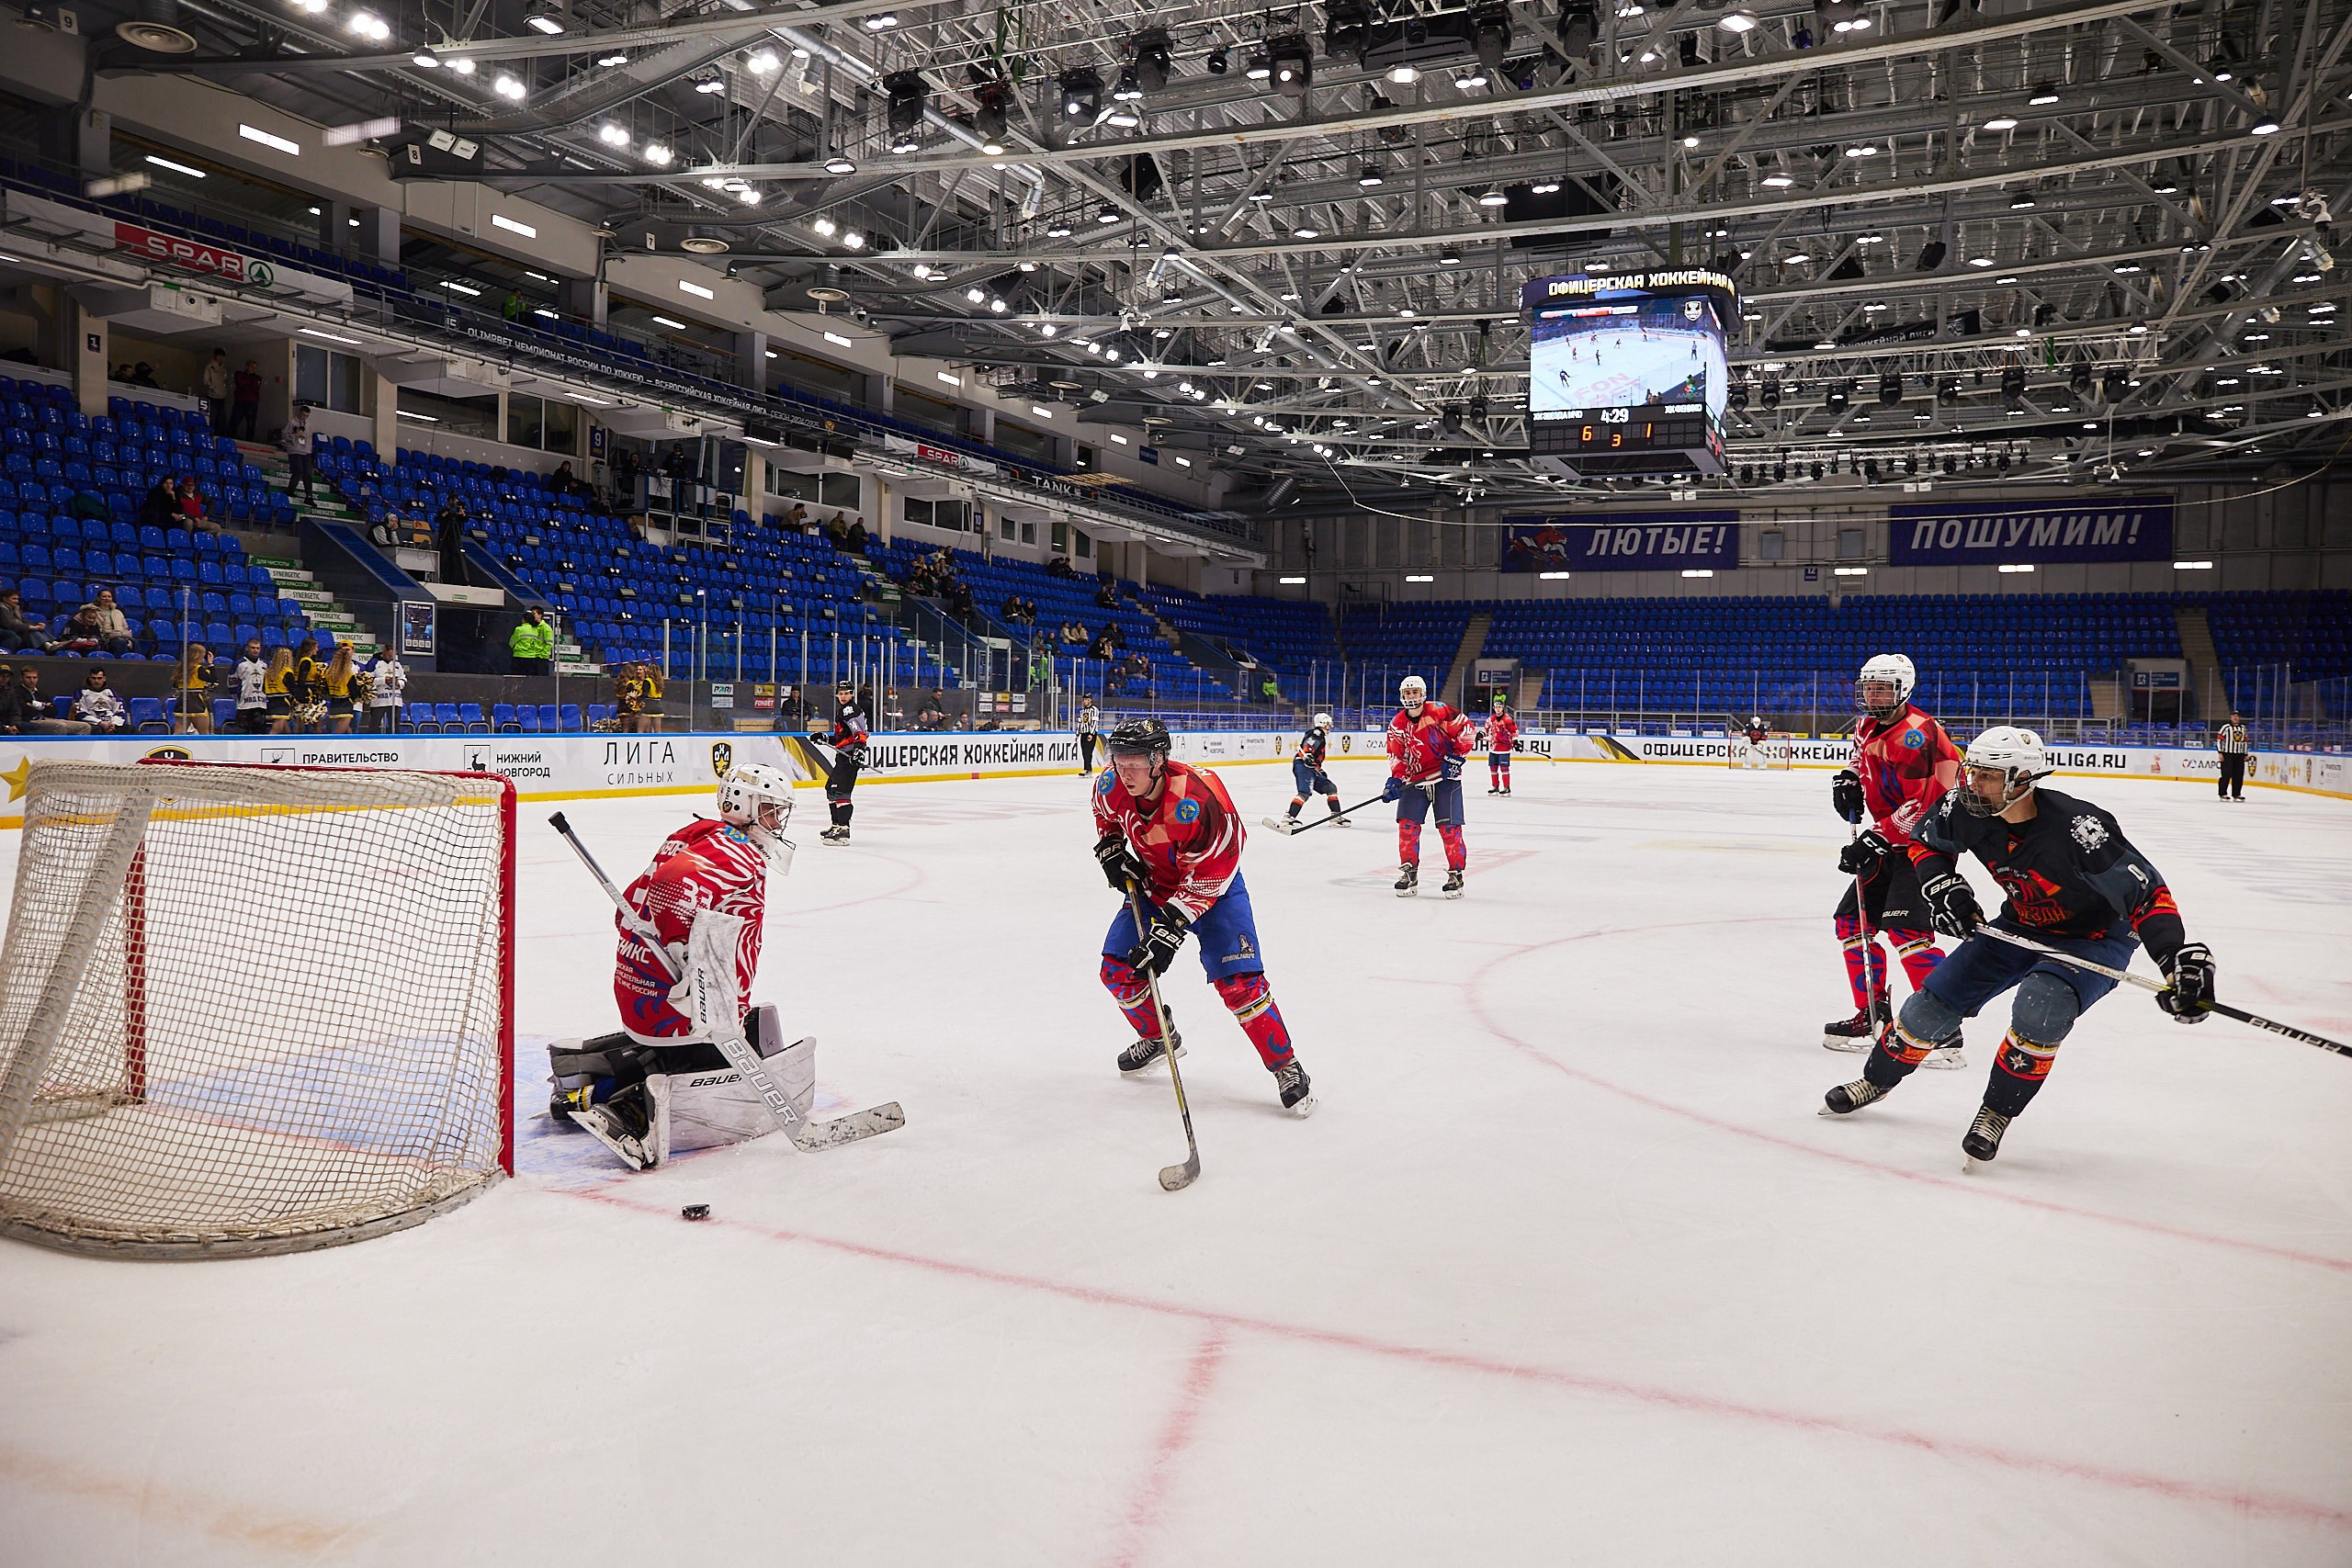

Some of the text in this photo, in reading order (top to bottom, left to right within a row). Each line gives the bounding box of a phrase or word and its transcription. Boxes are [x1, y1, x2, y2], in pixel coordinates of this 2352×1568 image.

[64, 16, 73, 28] 9
[412, 150, 418, 160] 8
[649, 238, 653, 246] 7
[147, 236, 241, 276] SPAR
[1548, 275, 1645, 296] ОФИЦЕРСКАЯ
[1648, 267, 1728, 288] ХОККЕЙНАЯ
[90, 337, 98, 347] 1
[514, 342, 565, 363] ЧЕМПИОНАТ
[568, 355, 599, 371] РОССИИ
[602, 365, 612, 375] ПО
[614, 367, 644, 382] ХОККЕЮ
[199, 400, 209, 411] 5
[1600, 408, 1630, 424] 4:29
[1582, 425, 1593, 442] 6
[1645, 423, 1652, 438] 1
[594, 432, 602, 446] 9
[1611, 434, 1622, 447] 3
[927, 448, 959, 466] SPAR
[1031, 475, 1073, 498] TANK
[1911, 513, 2142, 550] ПОШУМИМ!
[1587, 525, 1727, 555] ЛЮТЫЕ!
[272, 570, 300, 579] SYNERGETIC
[292, 591, 321, 601] SYNERGETIC
[313, 612, 341, 620] SYNERGETIC
[335, 633, 364, 641] SYNERGETIC
[302, 752, 399, 763] ПРАВИТЕЛЬСТВО
[496, 751, 542, 763] НИЖНИЙ
[604, 740, 675, 765] ЛИГА
[861, 738, 1079, 771] ФИЦЕРСКАЯ ХОККЕЙНАЯ ЛИГА
[1643, 743, 1747, 759] ОФИЦЕРСКА
[2045, 751, 2126, 769] HLIGA.RU
[496, 766, 551, 778] НОВГОРОД
[607, 772, 673, 785] СИЛЬНЫХ
[2127, 863, 2150, 890] 9
[678, 875, 714, 910] 33
[631, 985, 658, 998] РОССИИ
